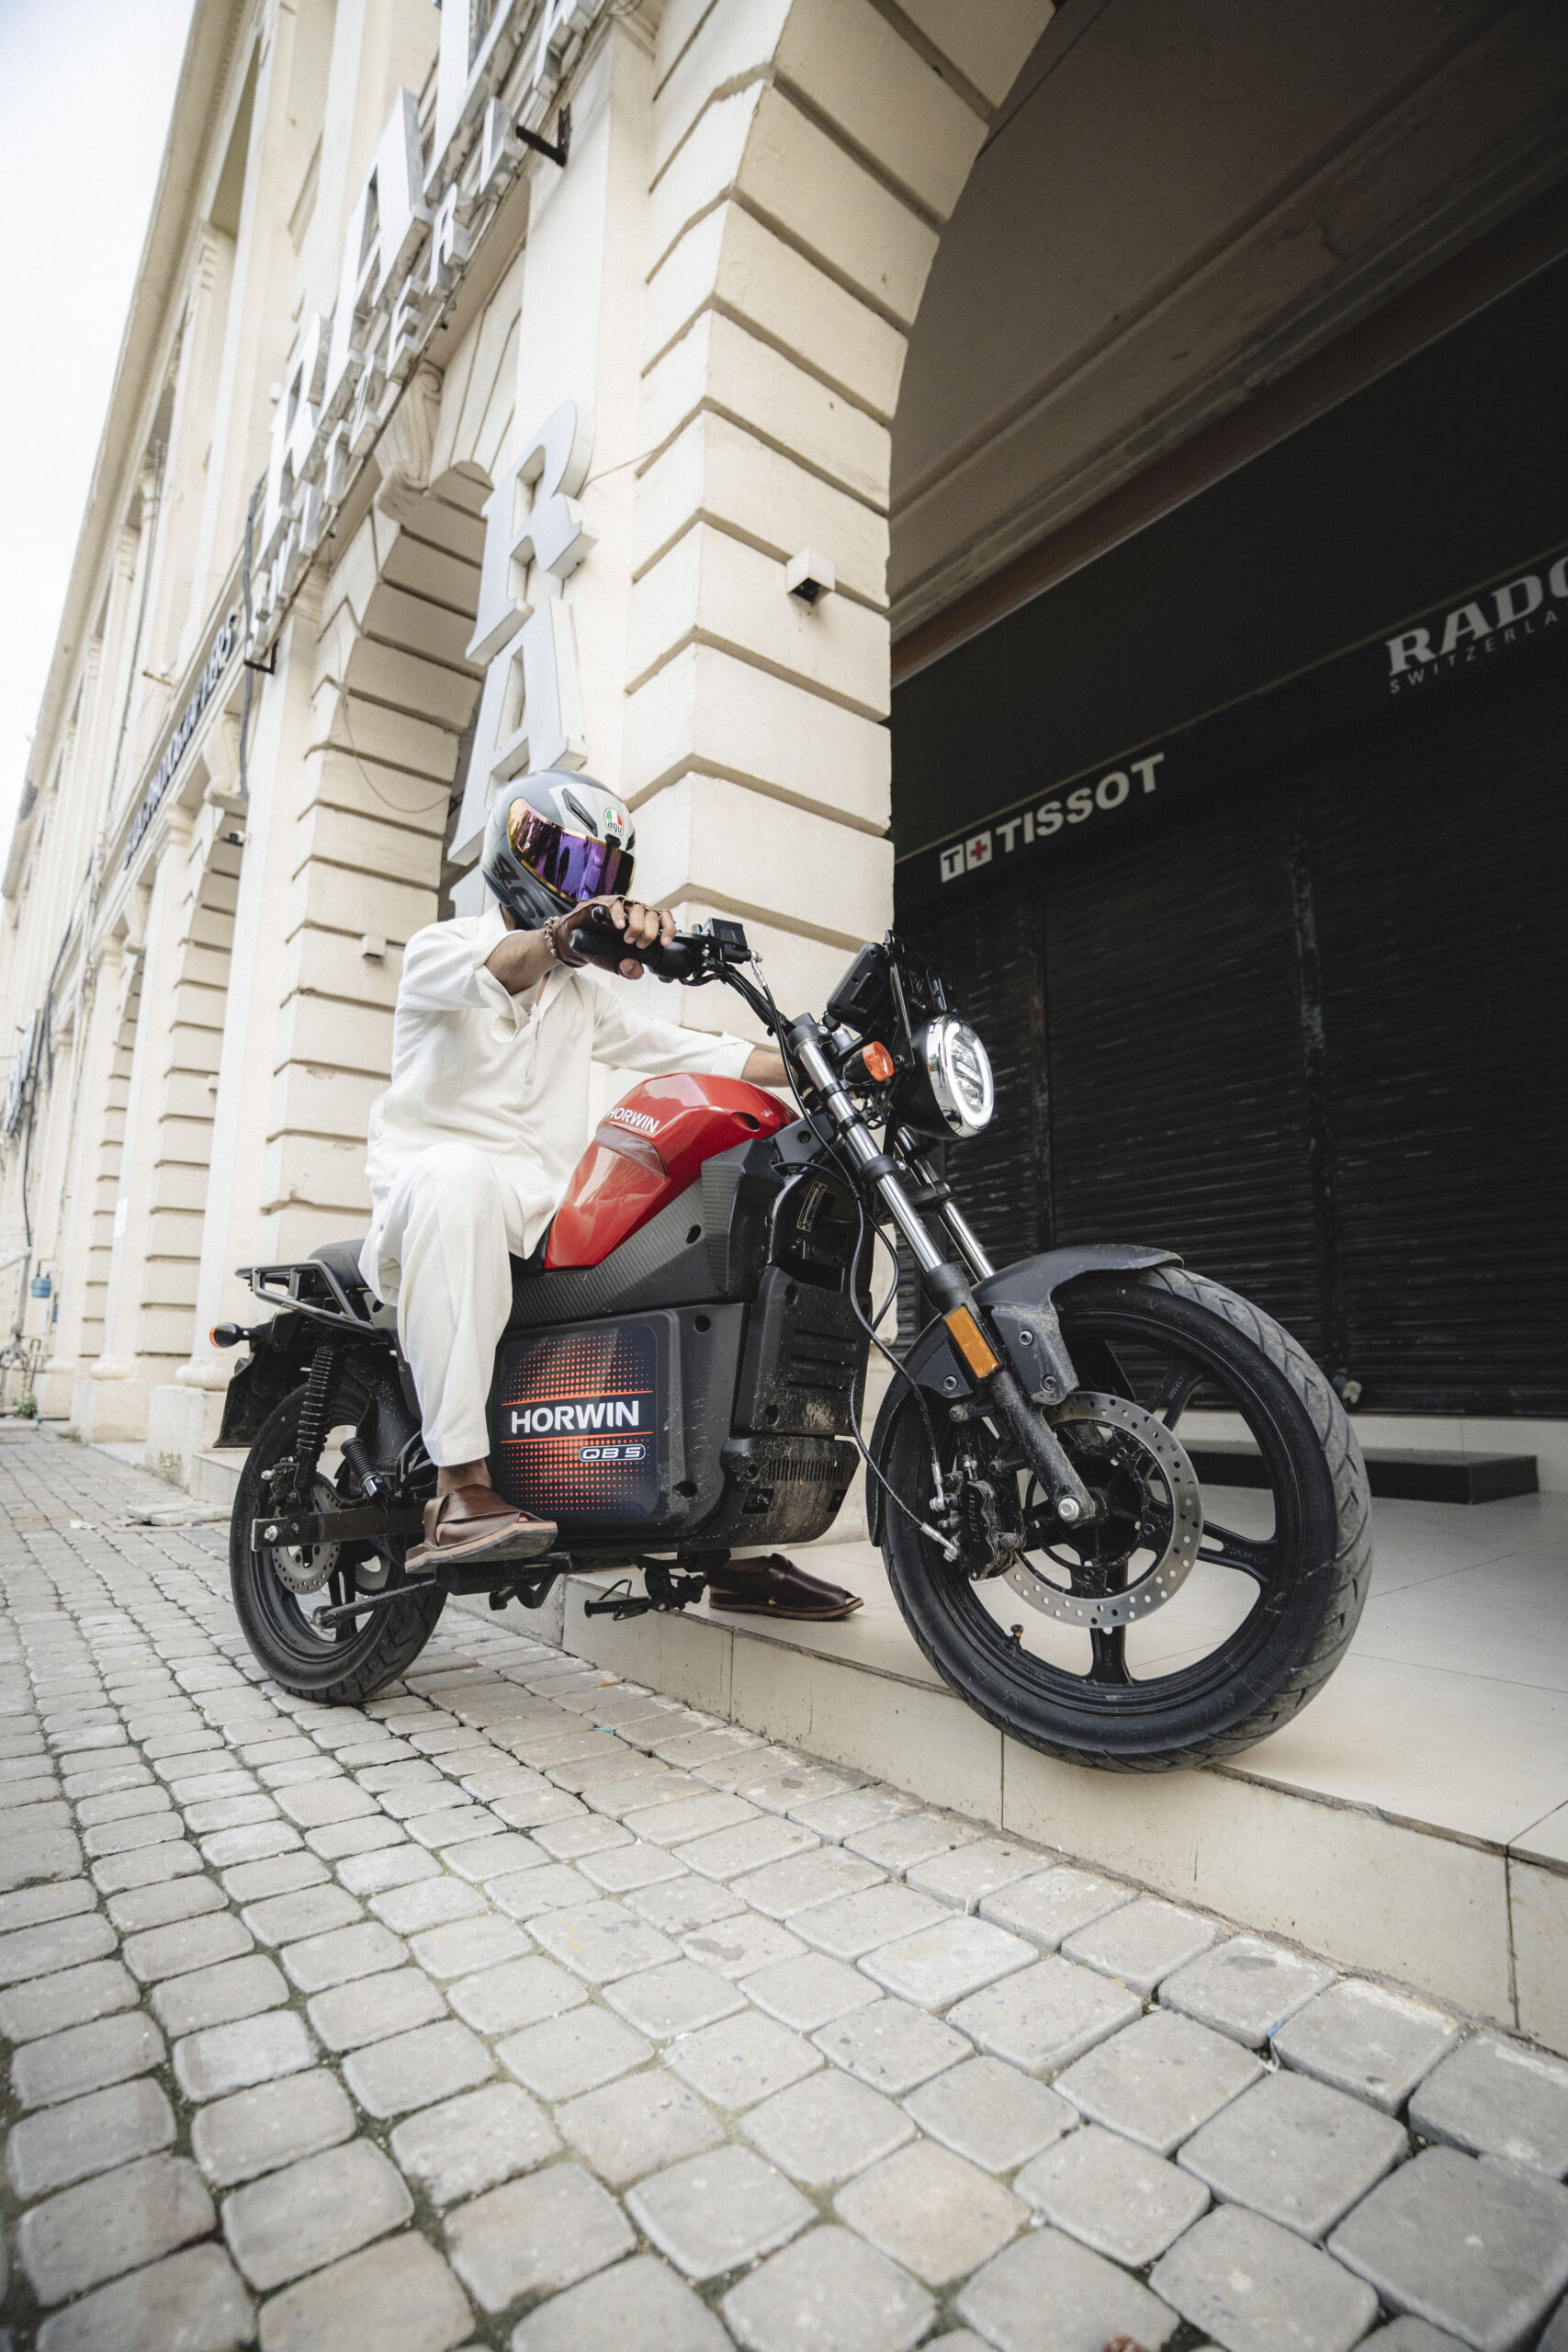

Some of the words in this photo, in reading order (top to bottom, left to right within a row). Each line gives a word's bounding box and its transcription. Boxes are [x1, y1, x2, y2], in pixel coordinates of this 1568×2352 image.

[447, 399, 589, 919] RA
[1389, 603, 1568, 694] SWITZERLA
[996, 752, 1165, 854] TISSOT
[606, 1107, 660, 1133] HORWIN
[511, 1400, 639, 1434] HORWIN
